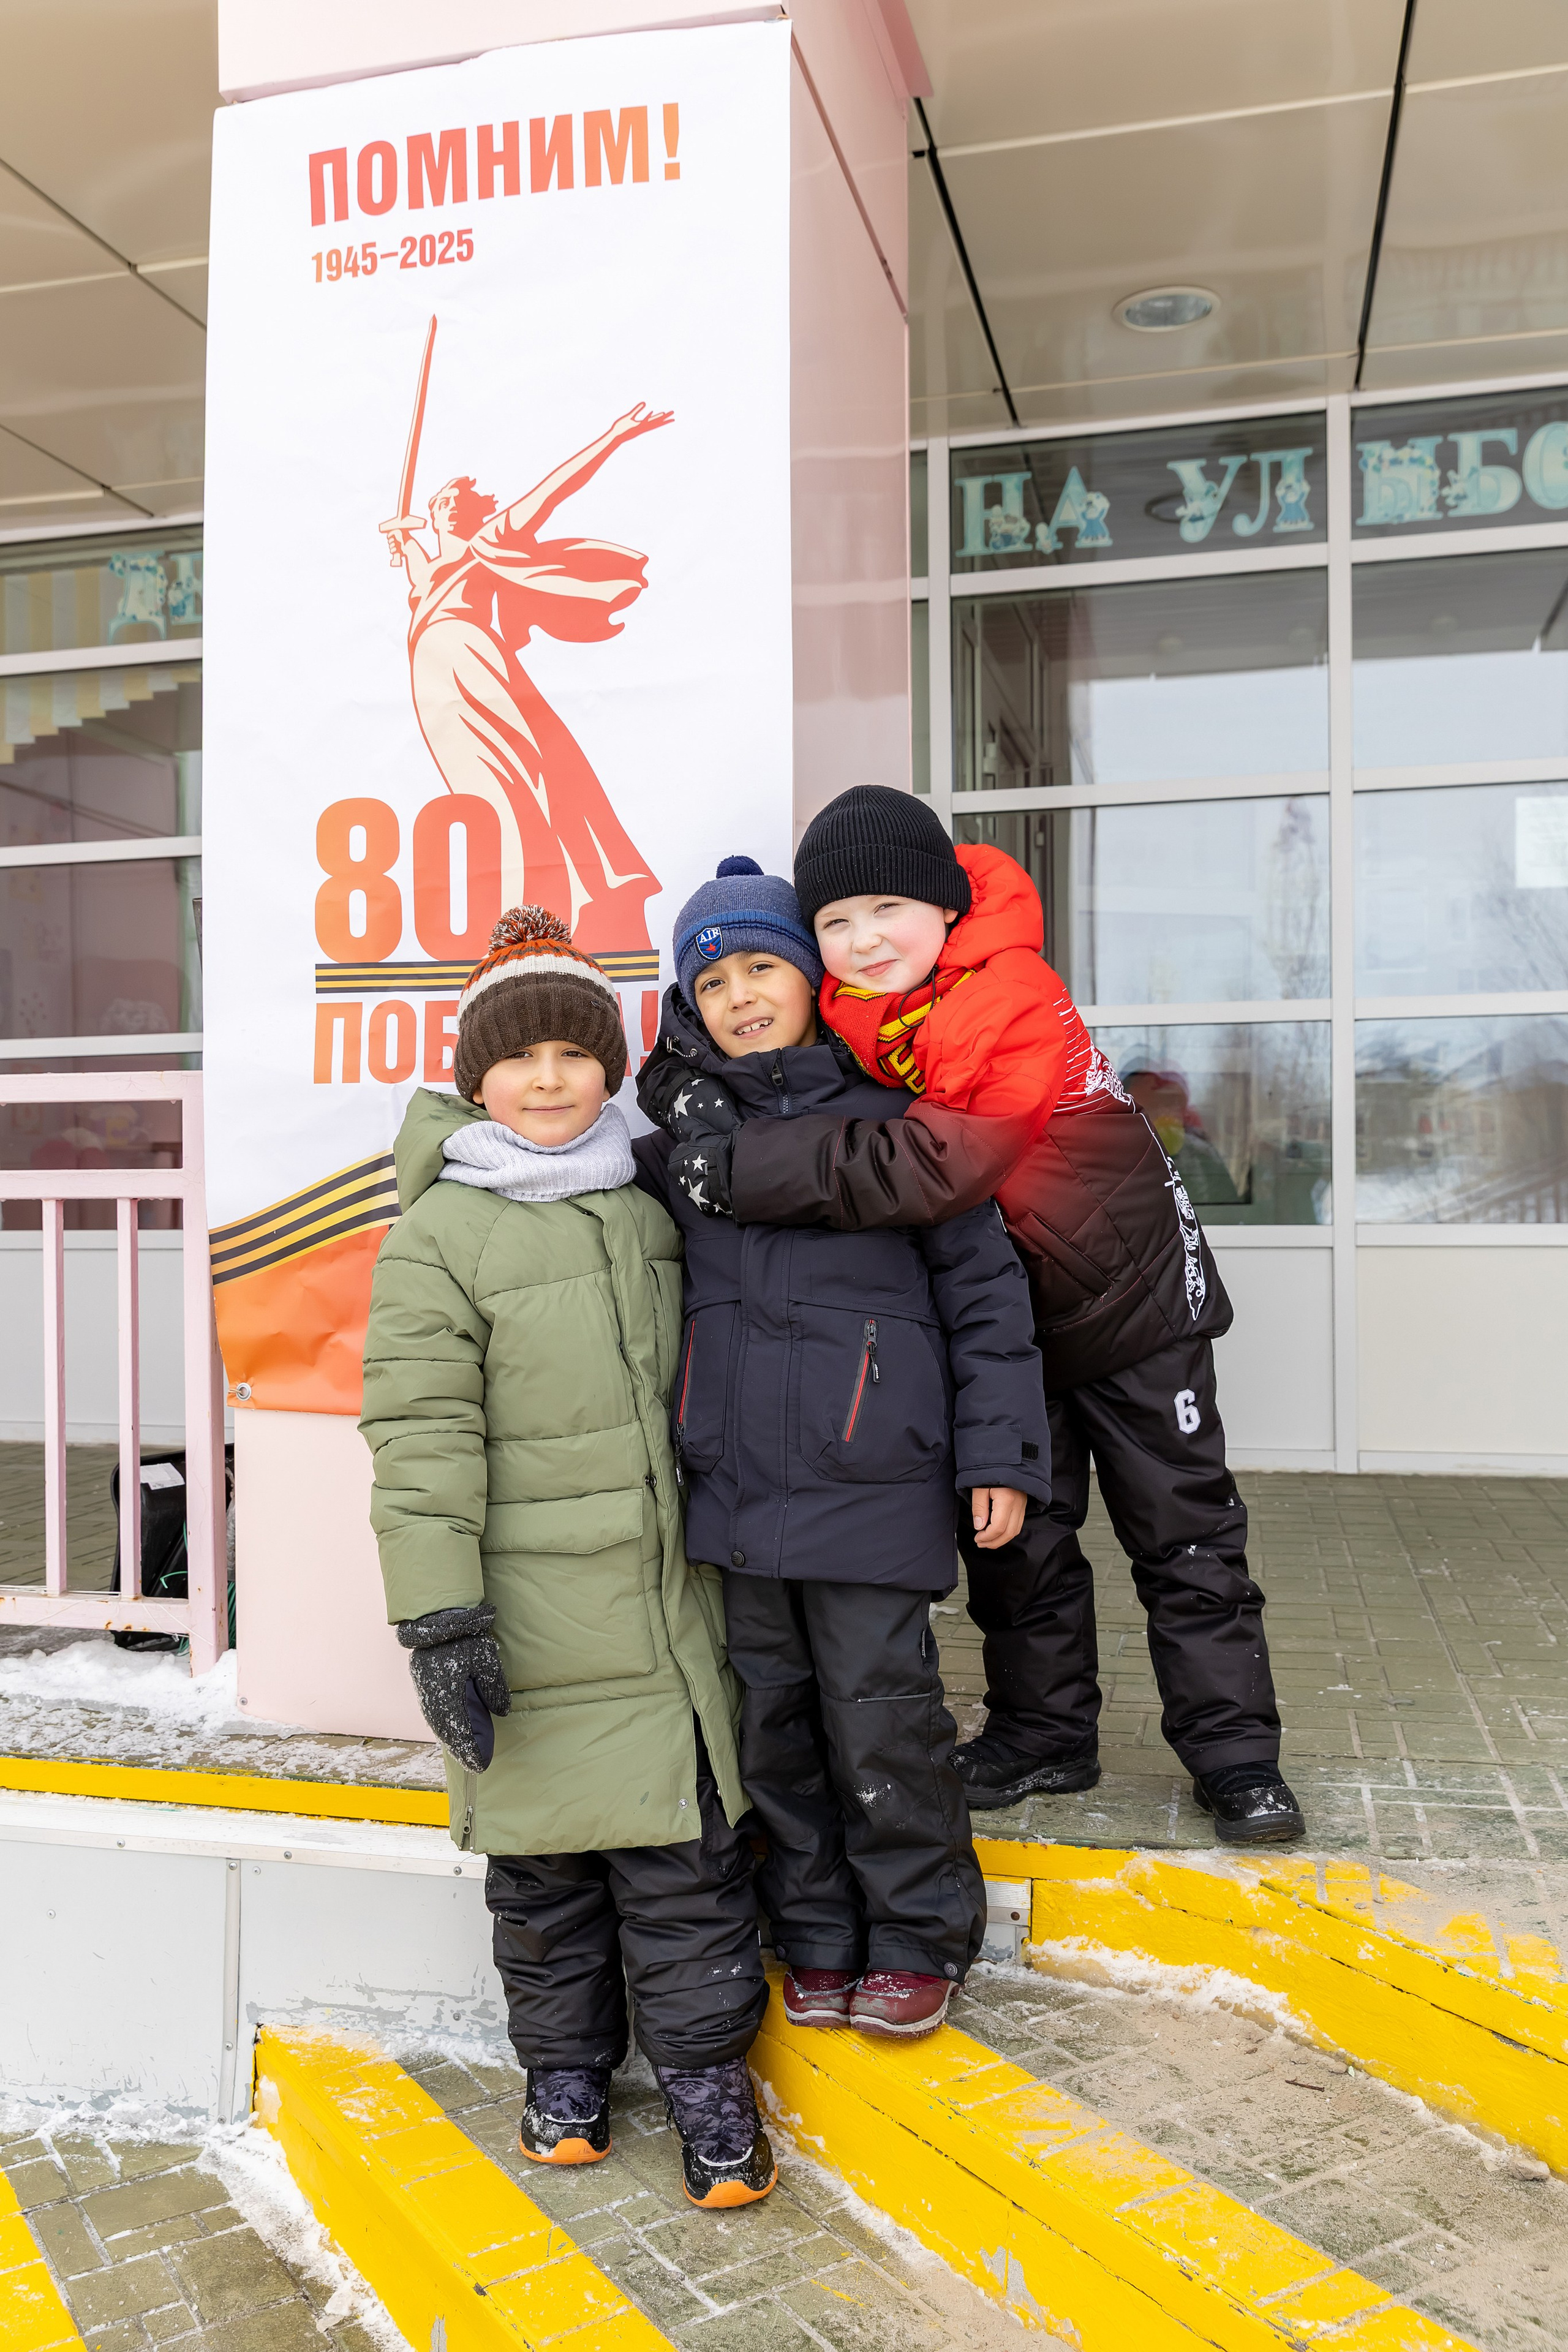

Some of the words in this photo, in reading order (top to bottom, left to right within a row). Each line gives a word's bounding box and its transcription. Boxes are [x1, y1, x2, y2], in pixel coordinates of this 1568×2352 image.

[309, 102, 680, 227] ПОМНИМ!
[315, 793, 502, 963] 80
[699, 929, 720, 943] AIR
[313, 990, 659, 1084] ПОБ!
[1174, 1389, 1201, 1434] 6
